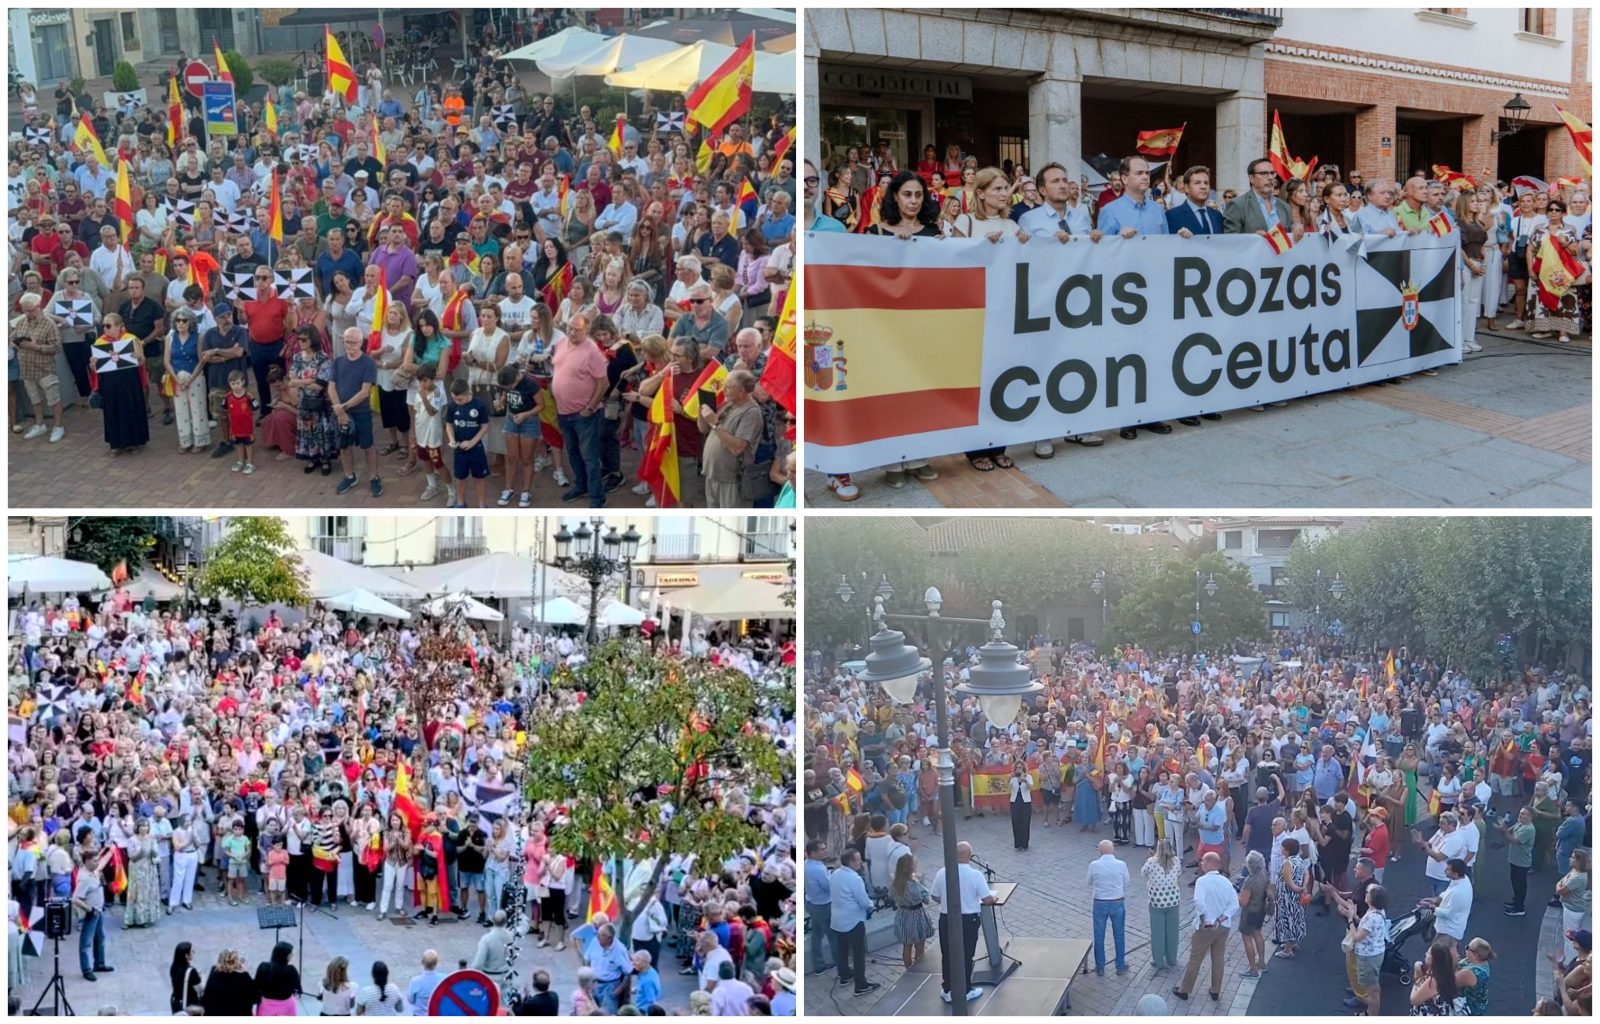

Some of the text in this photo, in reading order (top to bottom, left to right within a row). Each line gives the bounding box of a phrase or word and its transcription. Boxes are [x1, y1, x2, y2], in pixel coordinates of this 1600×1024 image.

[1013, 256, 1342, 334] Las Rozas
[989, 323, 1351, 423] con Ceuta
